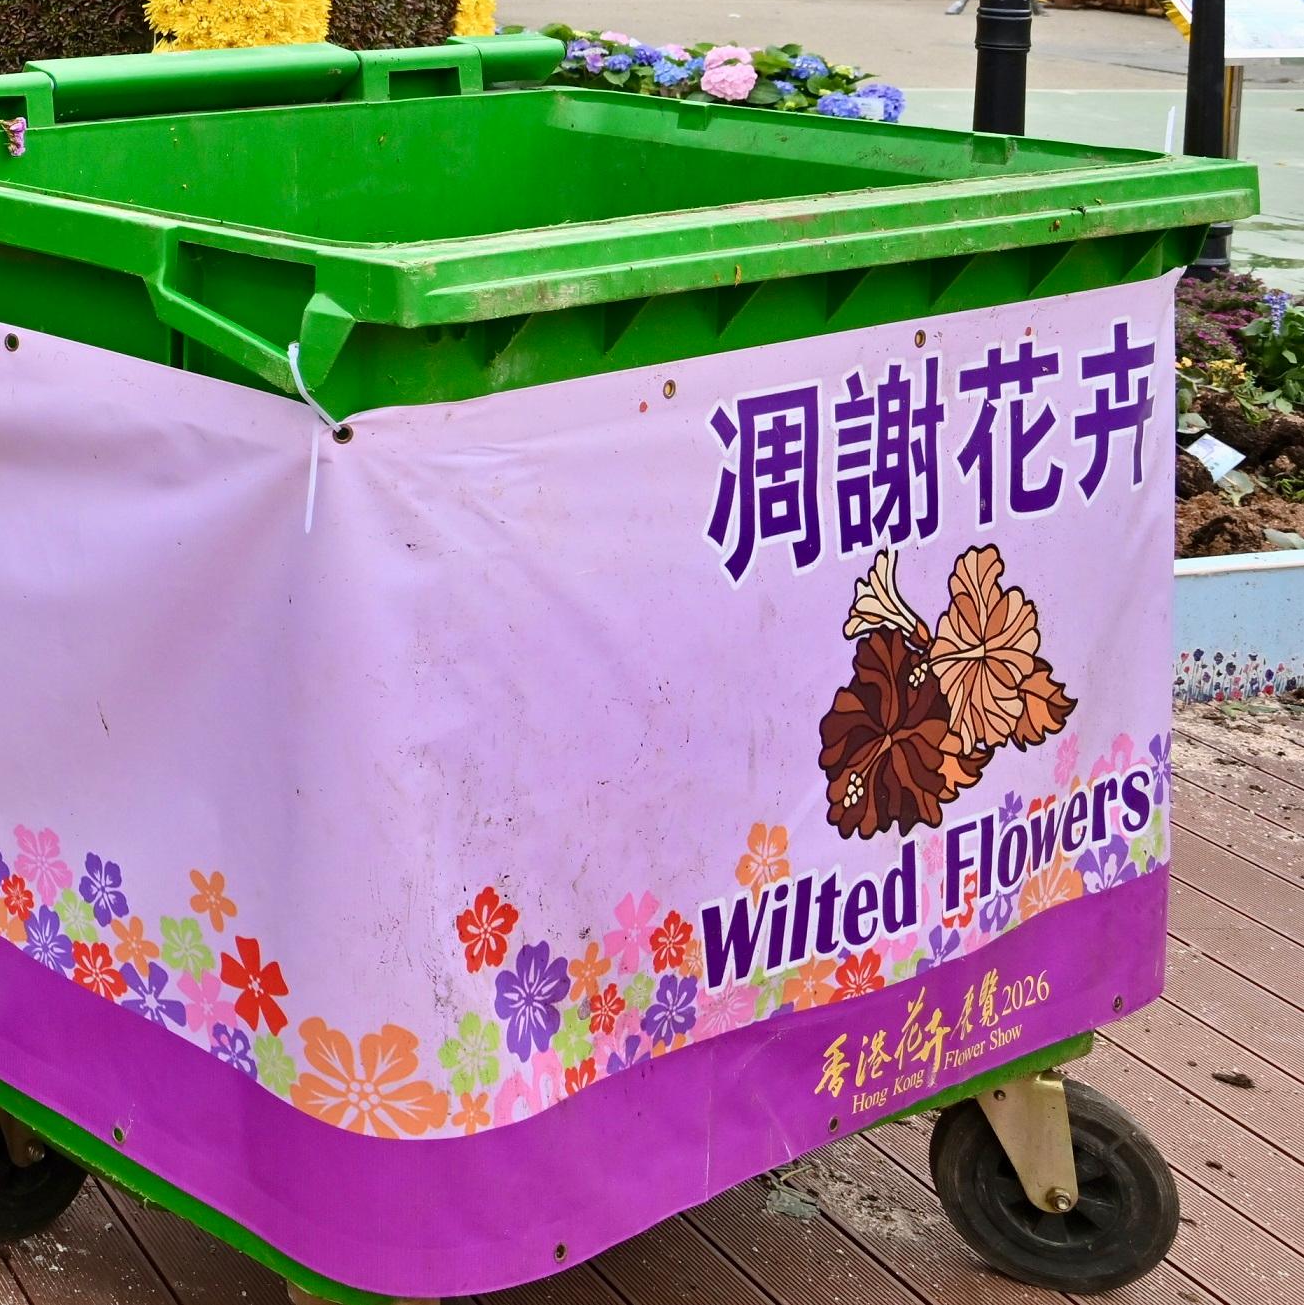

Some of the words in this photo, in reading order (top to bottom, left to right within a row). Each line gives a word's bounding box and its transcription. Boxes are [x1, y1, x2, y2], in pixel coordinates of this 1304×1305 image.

[706, 322, 1156, 583] 凋謝花卉
[700, 839, 919, 989] Wilted
[945, 769, 1153, 913] Flowers
[851, 1085, 888, 1115] Hong
[892, 1068, 925, 1096] Kong
[943, 1039, 987, 1071] Flower
[989, 1023, 1023, 1051] Show
